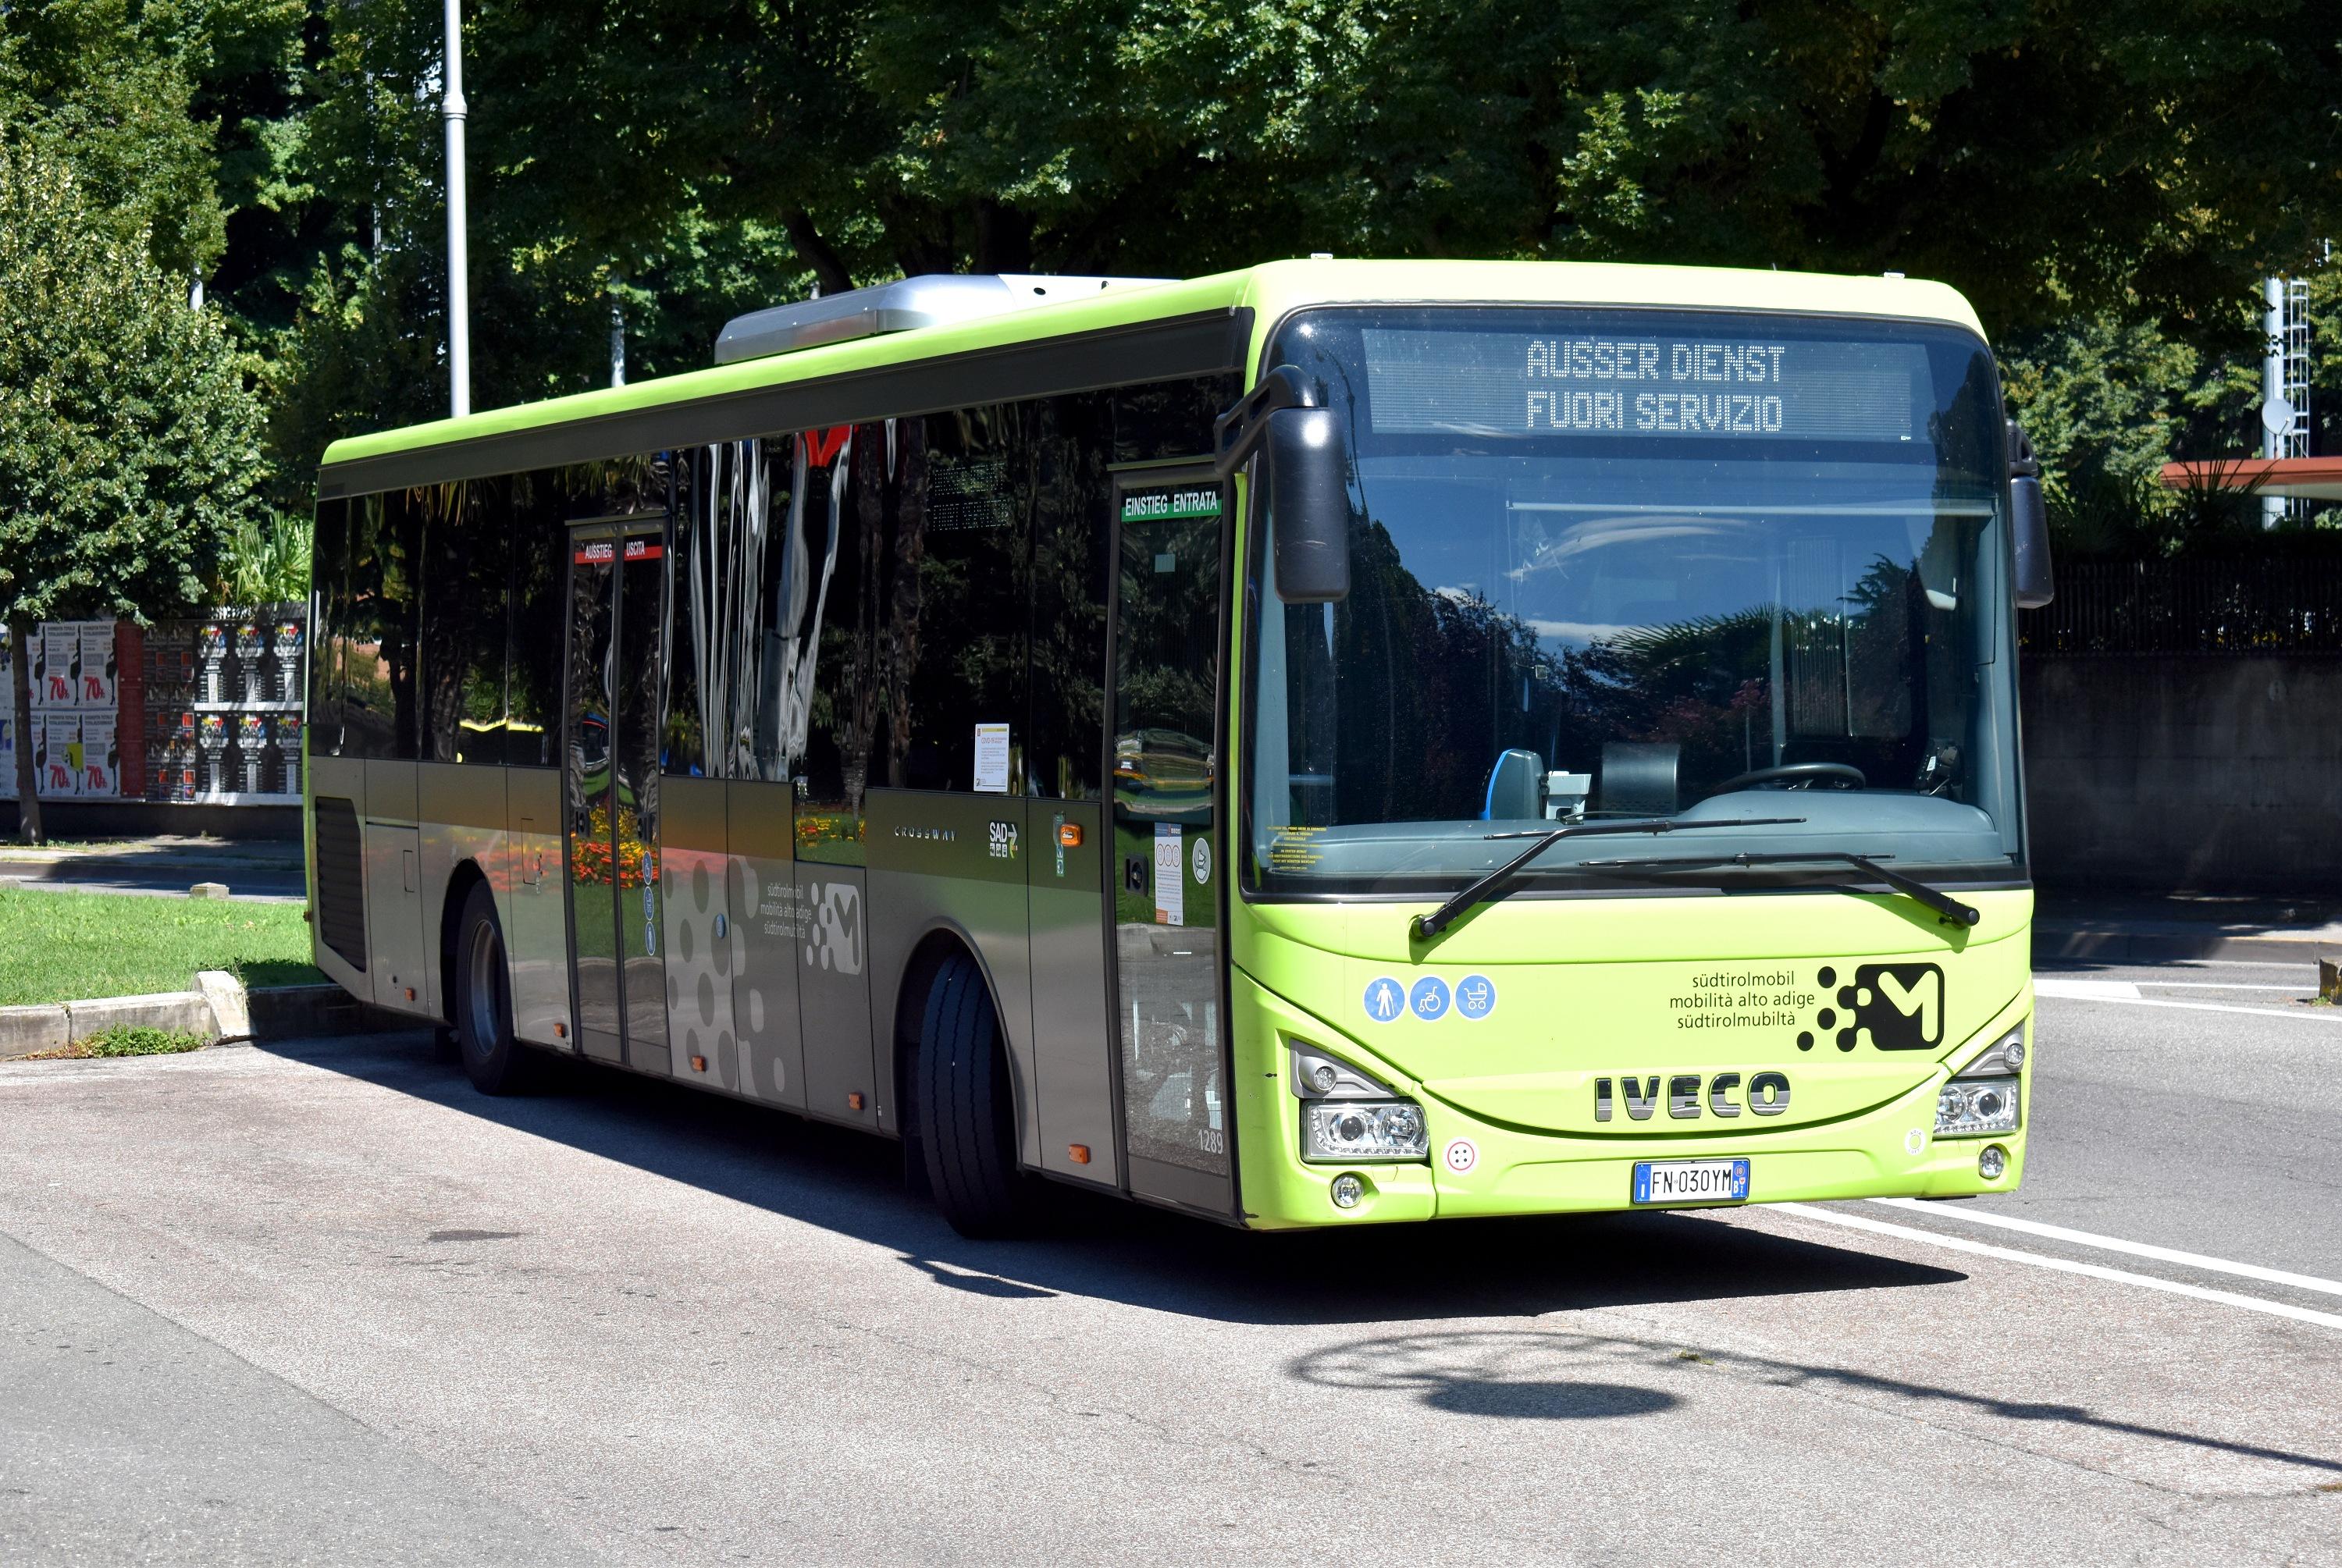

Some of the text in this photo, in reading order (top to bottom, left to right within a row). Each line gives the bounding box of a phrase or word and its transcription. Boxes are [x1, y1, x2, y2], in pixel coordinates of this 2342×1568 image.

[1527, 340, 1785, 382] AUSSER DIENST
[1527, 391, 1784, 432] FUORI SERVIZIO
[1125, 491, 1218, 517] EINSTIEG ENTRATA
[585, 541, 645, 560] AUSSTIEG USCITA
[48, 676, 69, 701] 70%
[84, 676, 105, 701] 70%
[50, 765, 70, 790] 70%
[86, 765, 107, 790] 70%
[894, 826, 956, 841] CROSSWAY
[989, 822, 1007, 843] SAD
[767, 882, 803, 900] südtirolmobil
[760, 901, 812, 923] mobilità alto adige
[1692, 970, 1794, 987] südtirolmobil
[1670, 990, 1815, 1009] mobilità alto adige
[1678, 1011, 1796, 1029] südtirolmubiltà
[1594, 1072, 1792, 1122] IVECO
[1198, 1129, 1223, 1154] 1289
